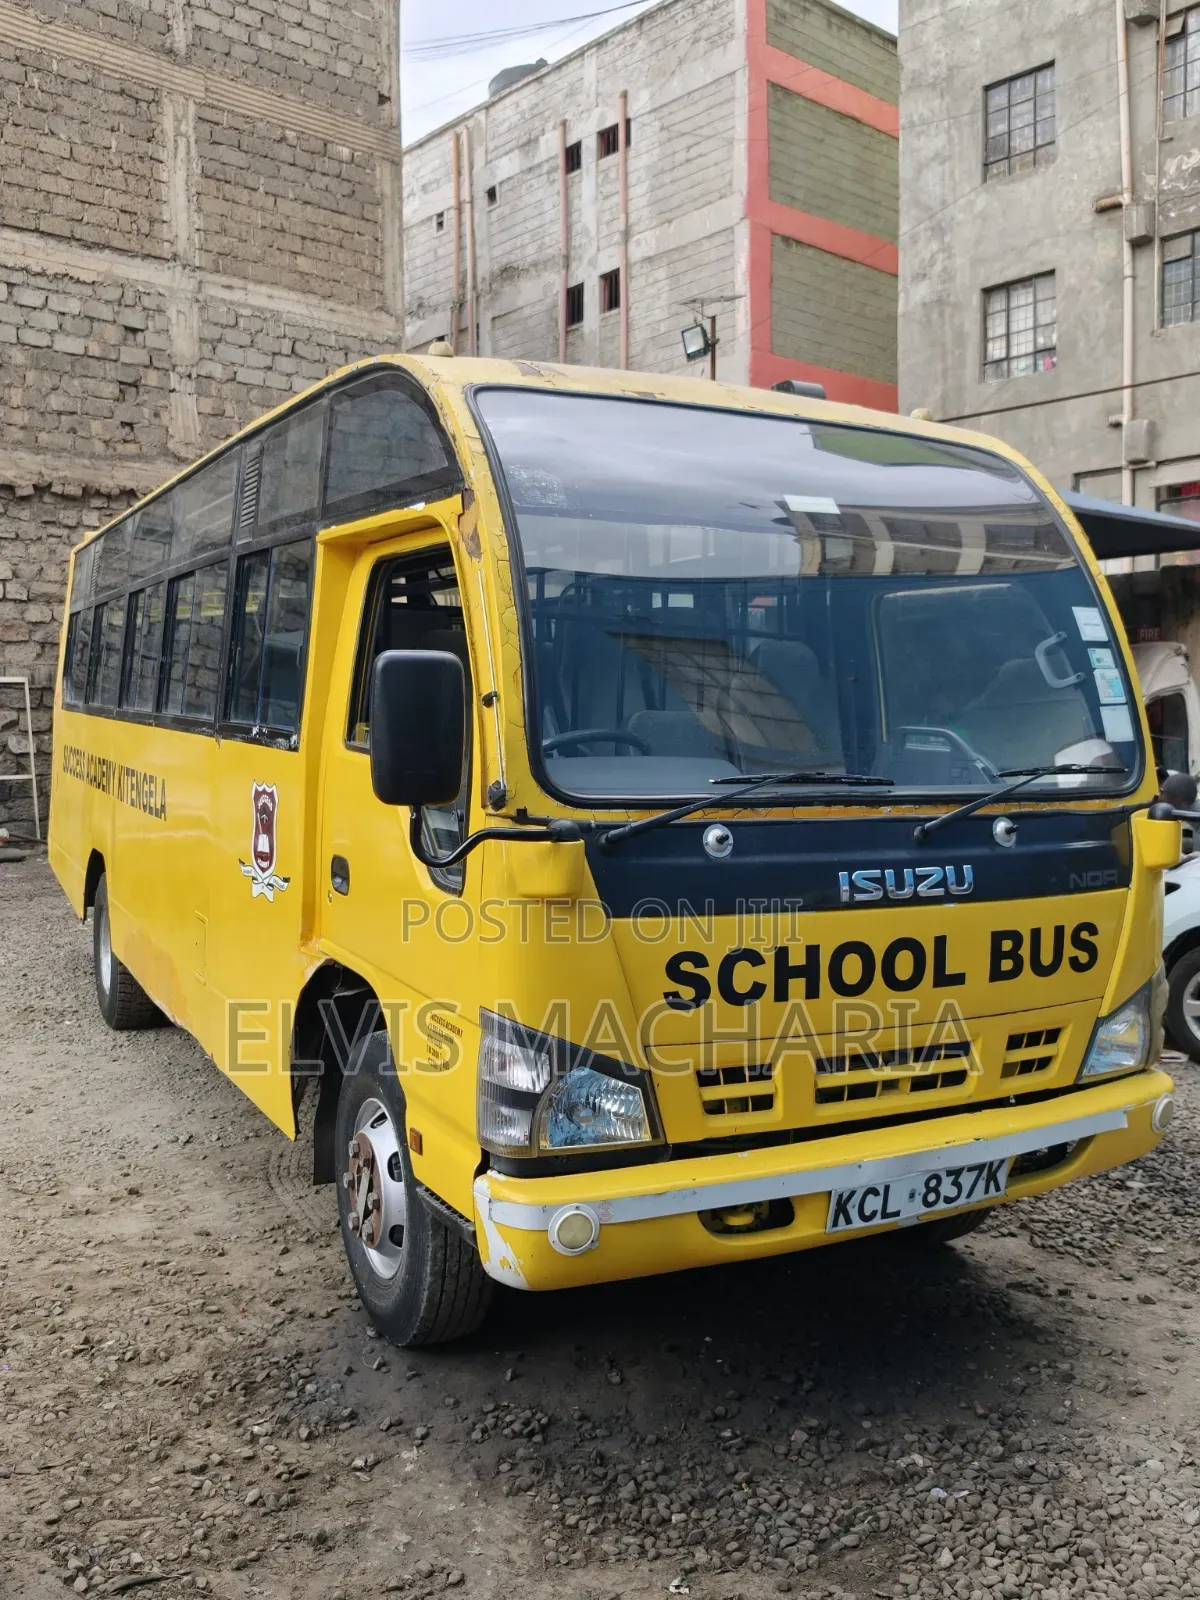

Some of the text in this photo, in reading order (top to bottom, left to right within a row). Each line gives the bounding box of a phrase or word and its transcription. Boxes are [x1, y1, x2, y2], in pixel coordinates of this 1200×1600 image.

[1139, 627, 1161, 641] FIRE
[63, 744, 167, 822] SUCCESS ACADEMY KITENGELA
[838, 864, 974, 902] ISUZU
[1069, 869, 1118, 889] NQR
[663, 921, 1099, 1012] SCHOOL BUS
[832, 1158, 1007, 1228] KCL 837K
